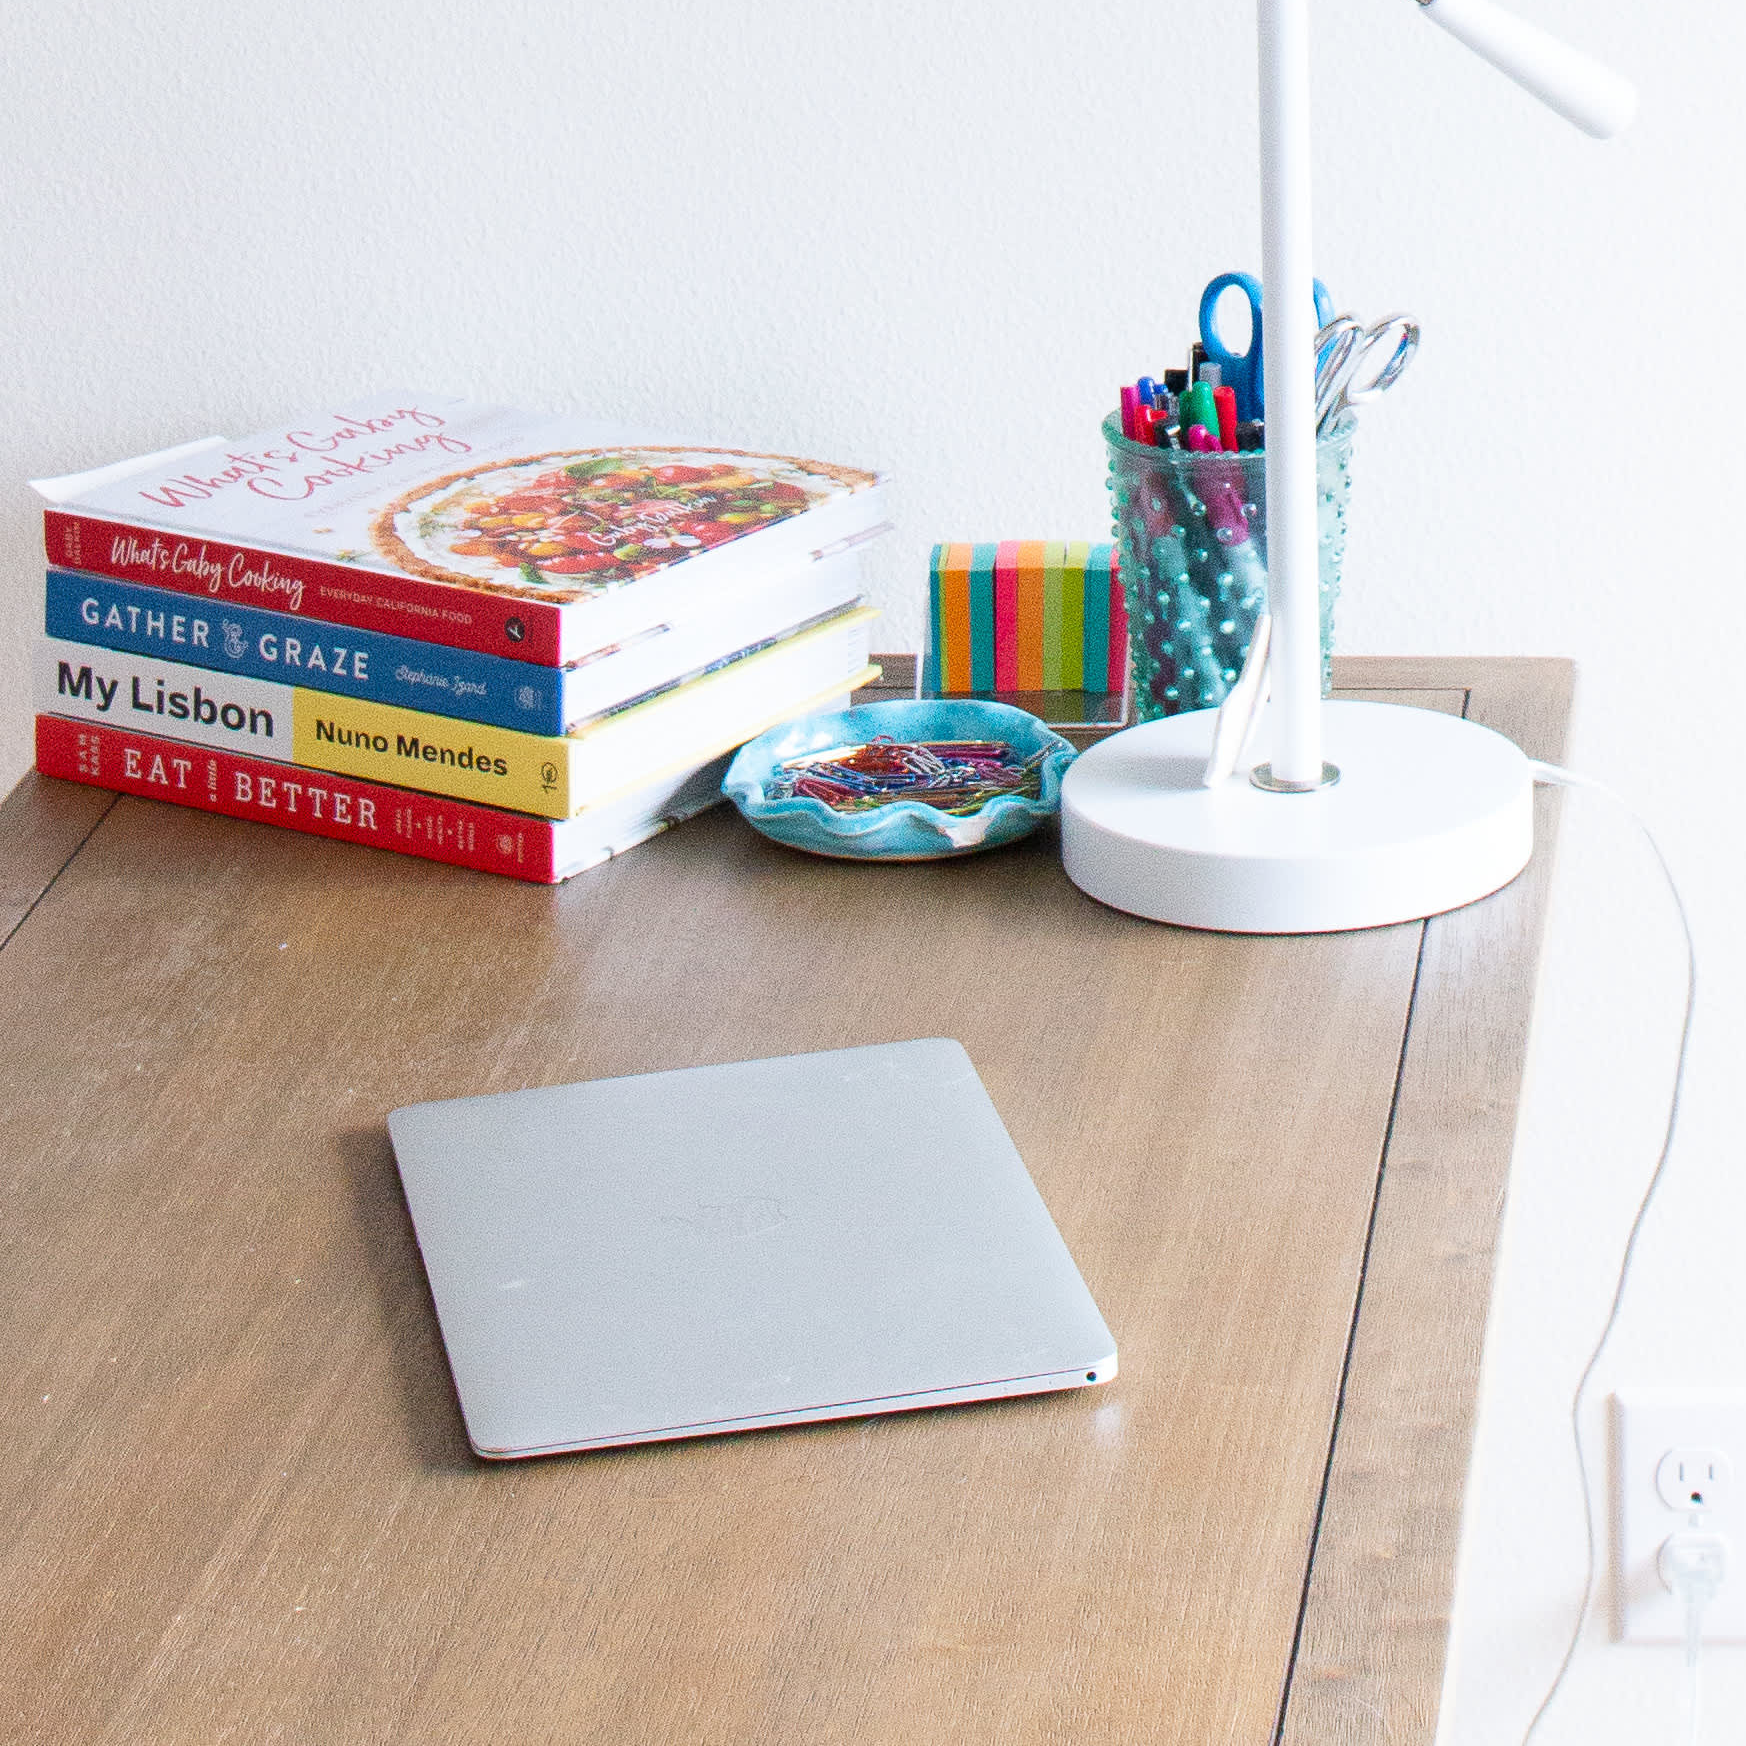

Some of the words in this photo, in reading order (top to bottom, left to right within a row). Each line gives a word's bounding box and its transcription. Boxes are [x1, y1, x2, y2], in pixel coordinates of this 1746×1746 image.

[139, 448, 299, 508] What's
[286, 404, 445, 451] Gaby
[248, 432, 472, 501] Cooking
[110, 535, 169, 571] What's
[172, 543, 222, 593] Gaby
[228, 552, 305, 611] Cooking
[320, 586, 373, 605] EVERYDAY
[376, 597, 439, 617] CALIFORNIA
[442, 609, 473, 625] FOOD
[81, 597, 210, 648] GATHER
[258, 633, 370, 680] GRAZE
[57, 660, 119, 712] My
[131, 675, 274, 738] Lisbon
[315, 719, 388, 753] Nuno
[396, 735, 508, 777] Mendes
[124, 748, 192, 789] EAT
[235, 771, 378, 830] BETTER
